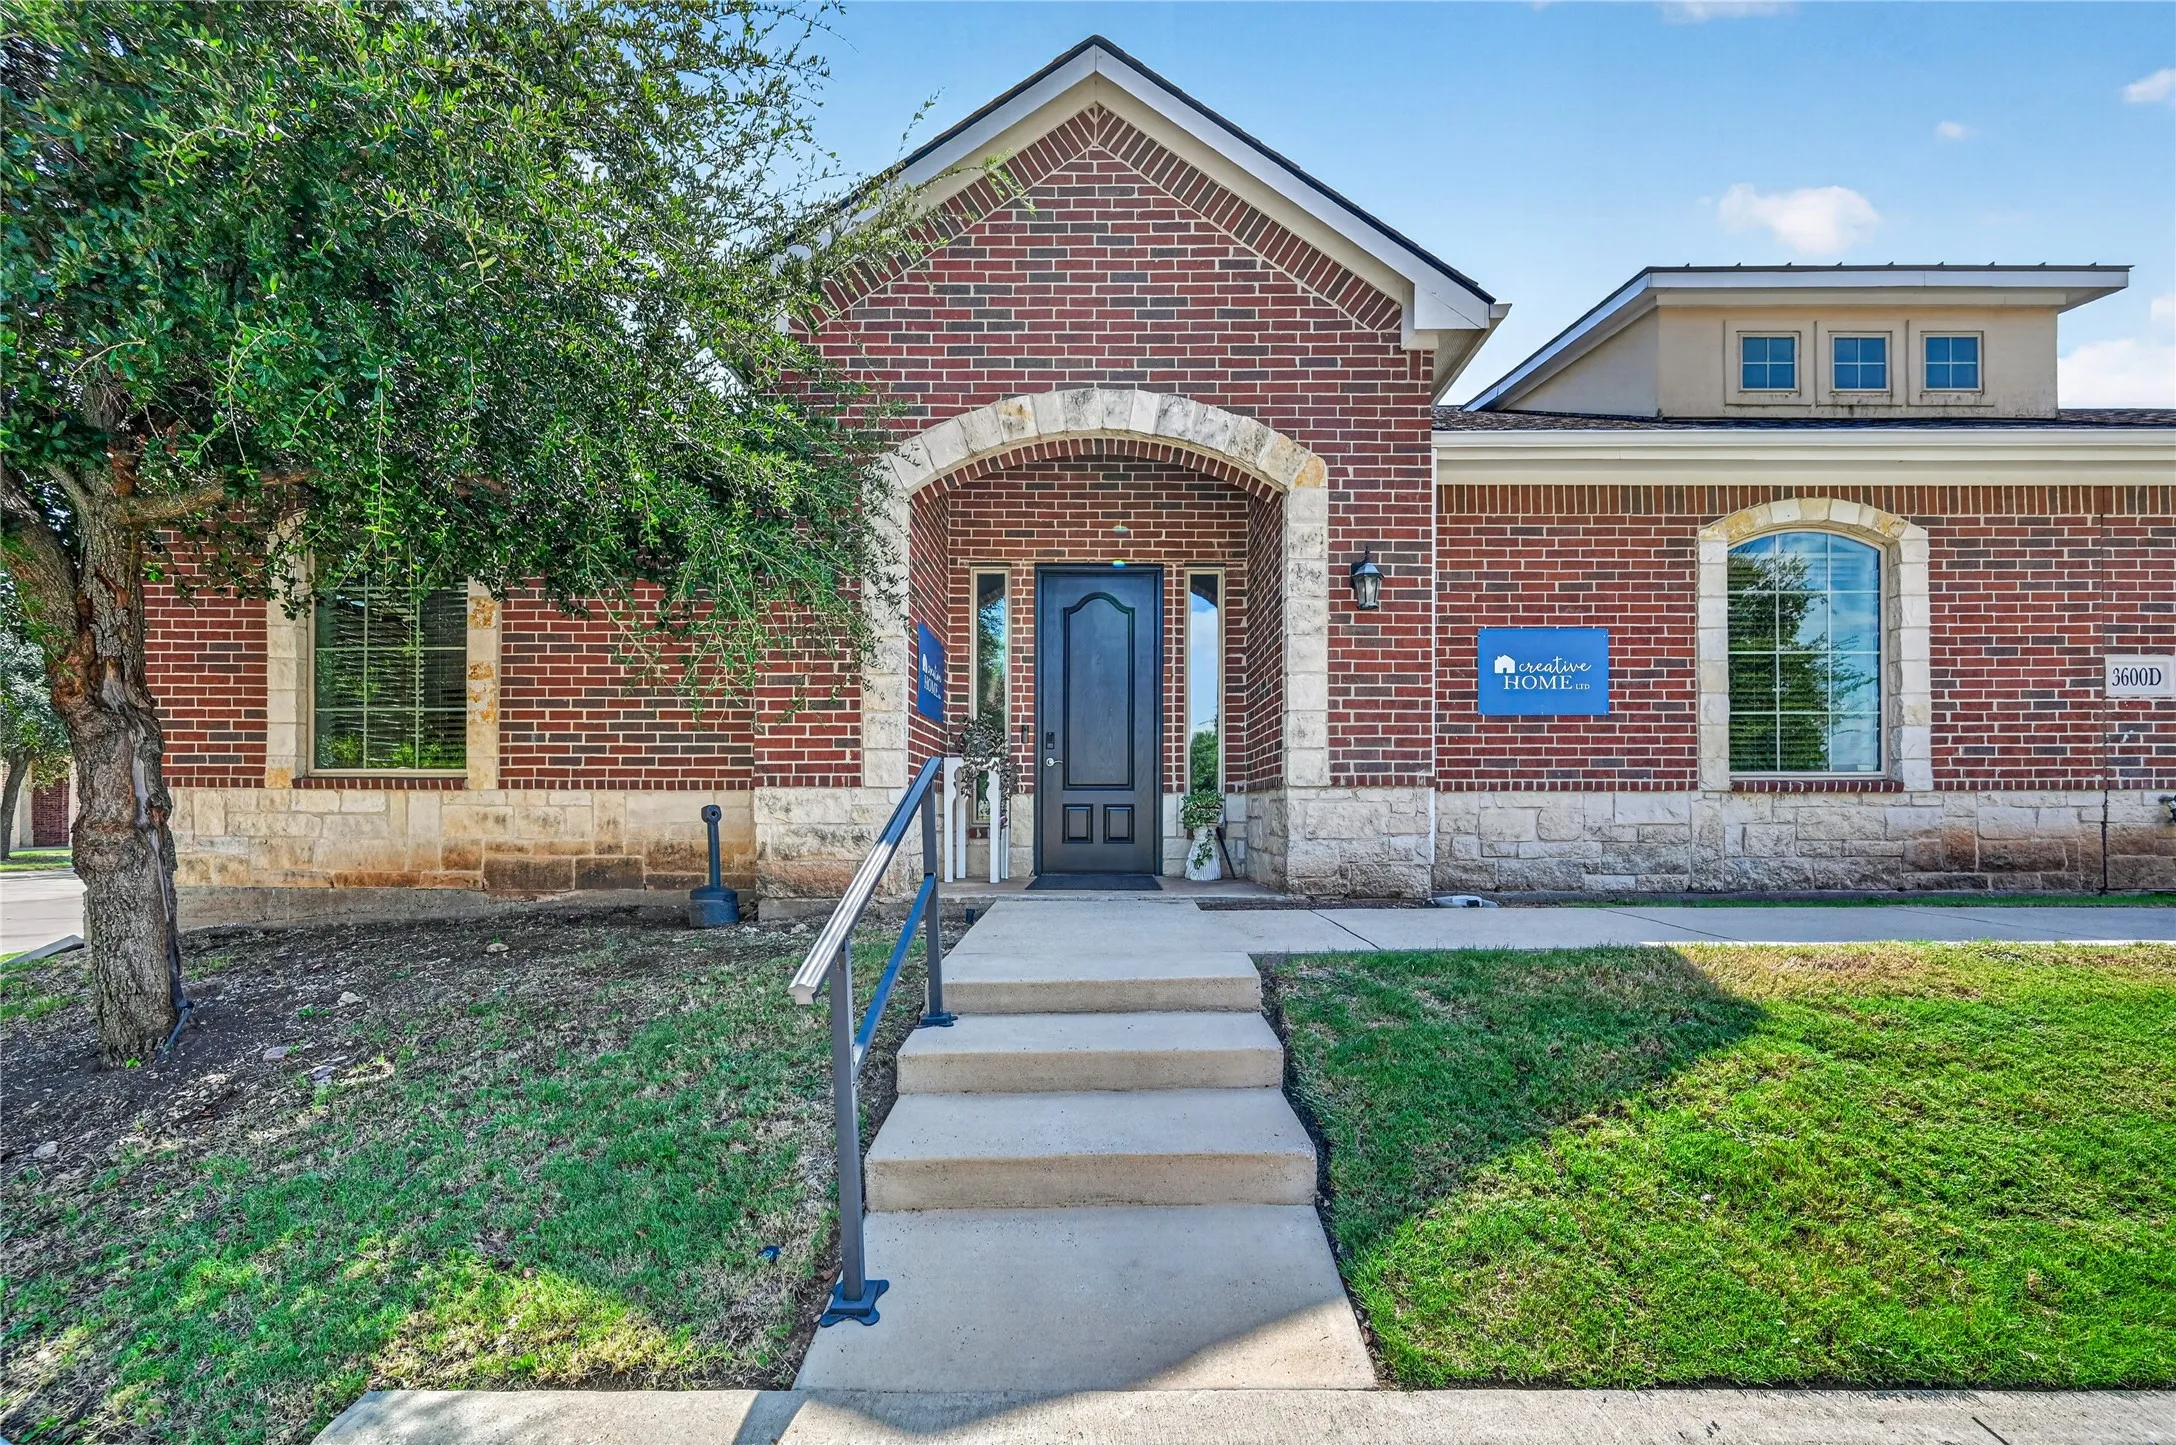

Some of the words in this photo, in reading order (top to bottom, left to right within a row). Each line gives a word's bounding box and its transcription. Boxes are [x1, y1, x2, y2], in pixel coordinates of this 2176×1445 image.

[1519, 656, 1592, 674] creative
[1503, 675, 1573, 690] HOME
[2112, 667, 2162, 686] 3600D
